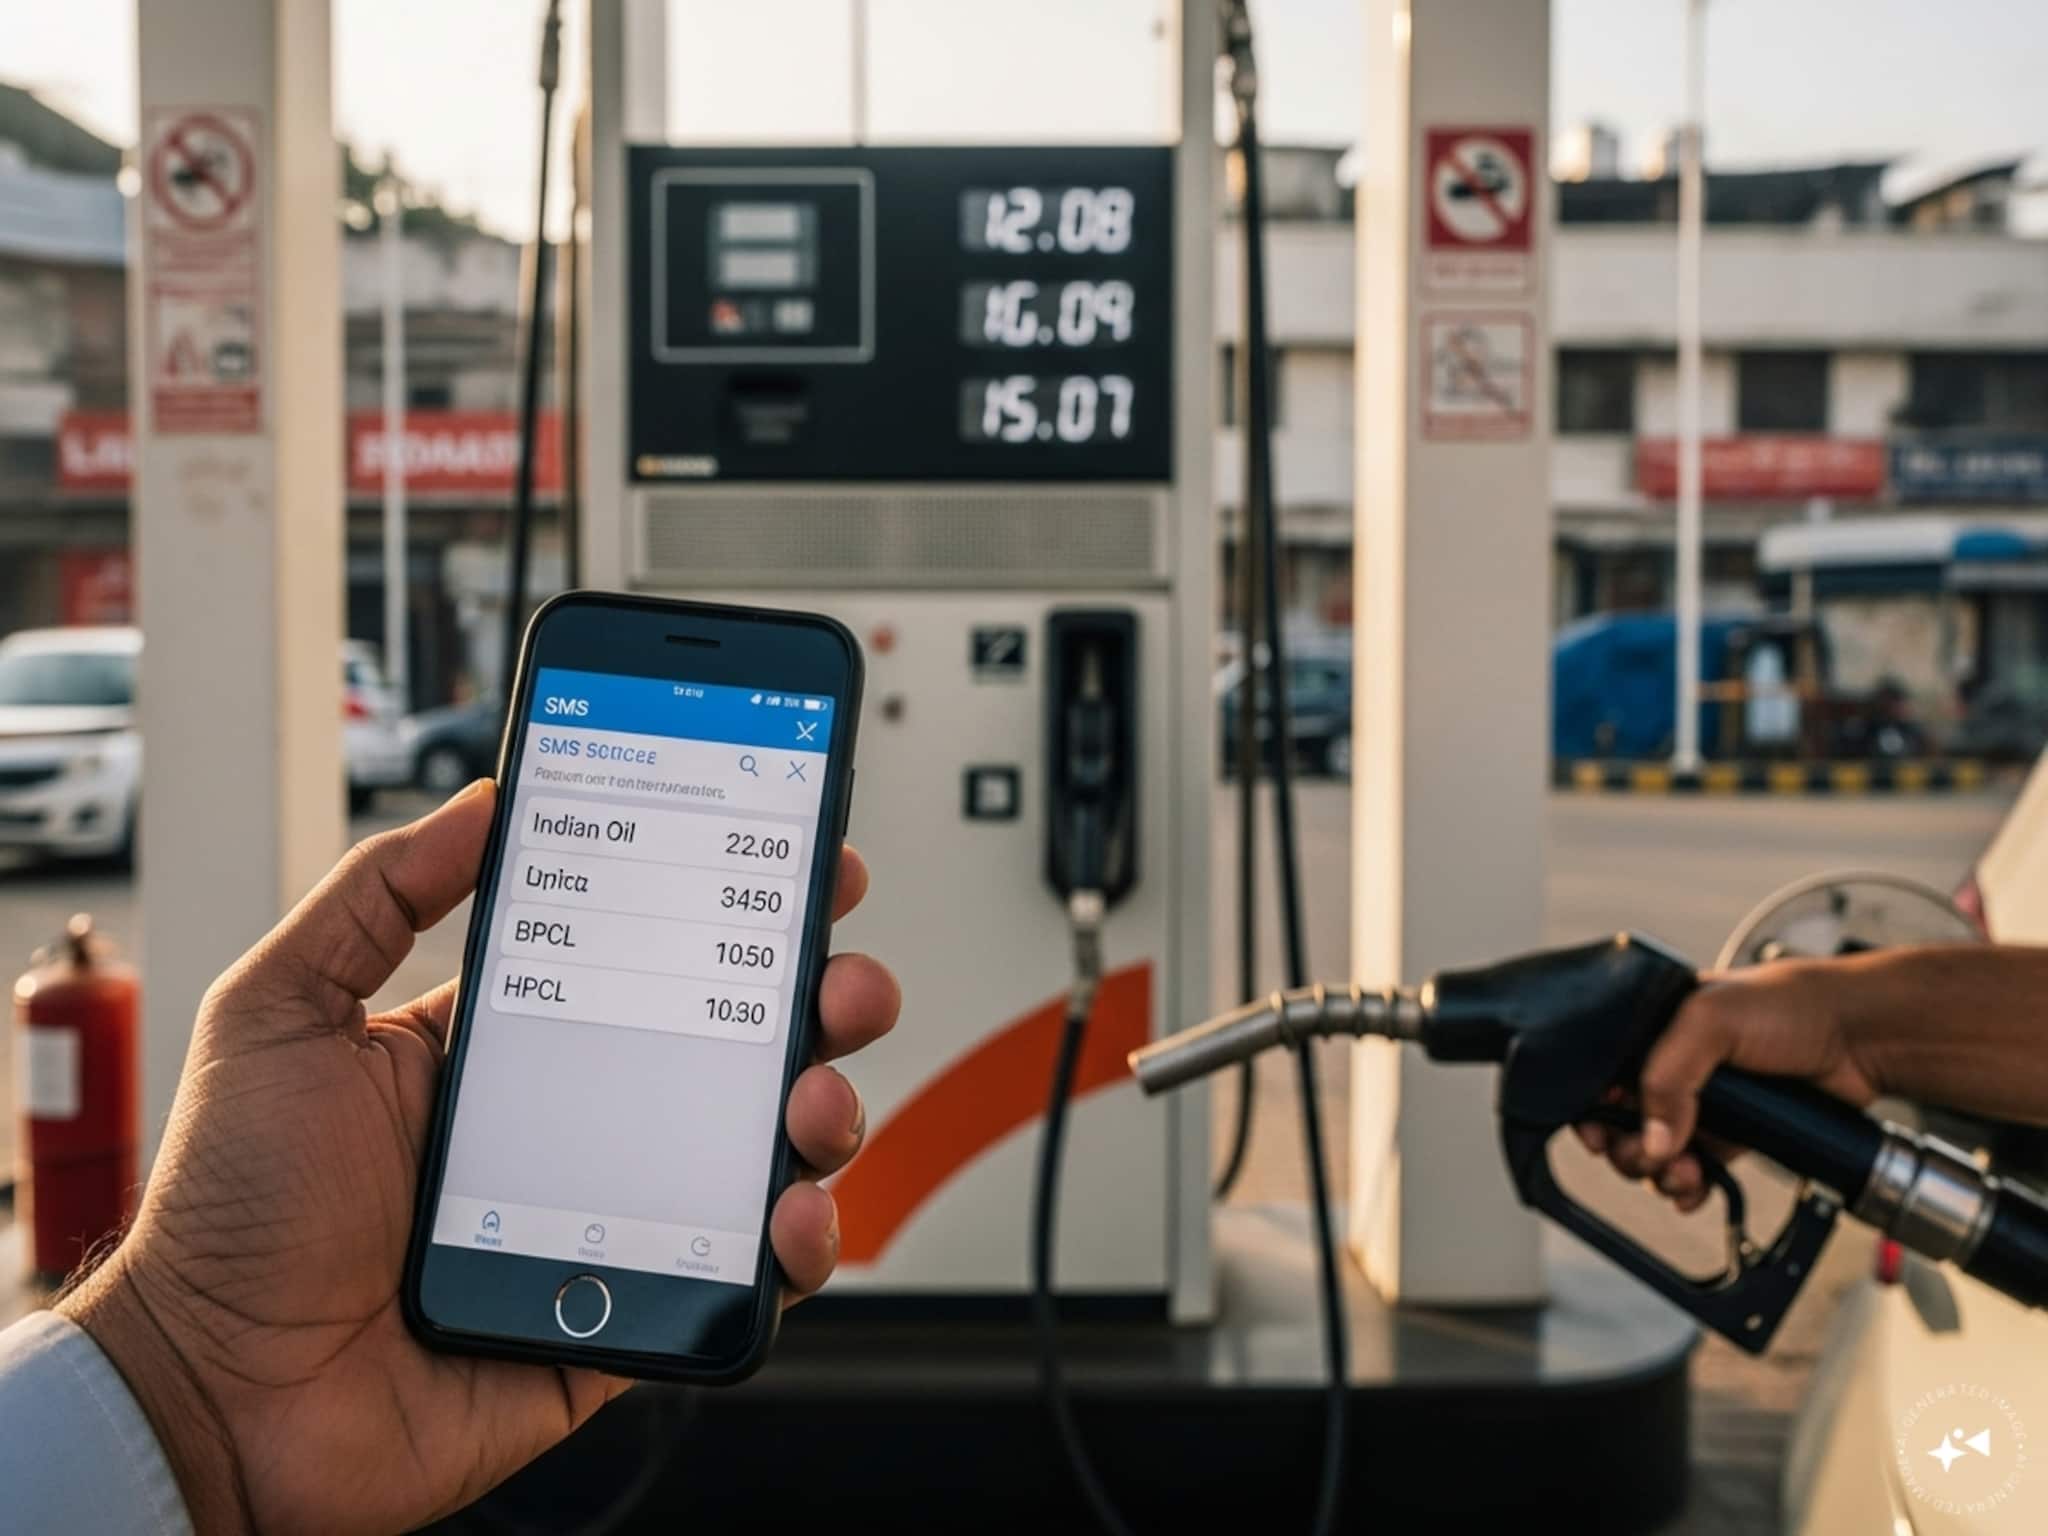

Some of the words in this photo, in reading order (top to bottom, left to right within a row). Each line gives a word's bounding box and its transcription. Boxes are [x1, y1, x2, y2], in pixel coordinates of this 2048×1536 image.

[985, 186, 1135, 253] 12.08
[982, 375, 1134, 443] 15.07
[545, 696, 590, 717] SMS
[538, 737, 581, 757] SMS
[533, 812, 600, 839] Indian
[606, 819, 636, 843] Oil
[515, 920, 576, 947] BPCL
[503, 974, 567, 1002] HPCL
[706, 998, 766, 1026] 10.30
